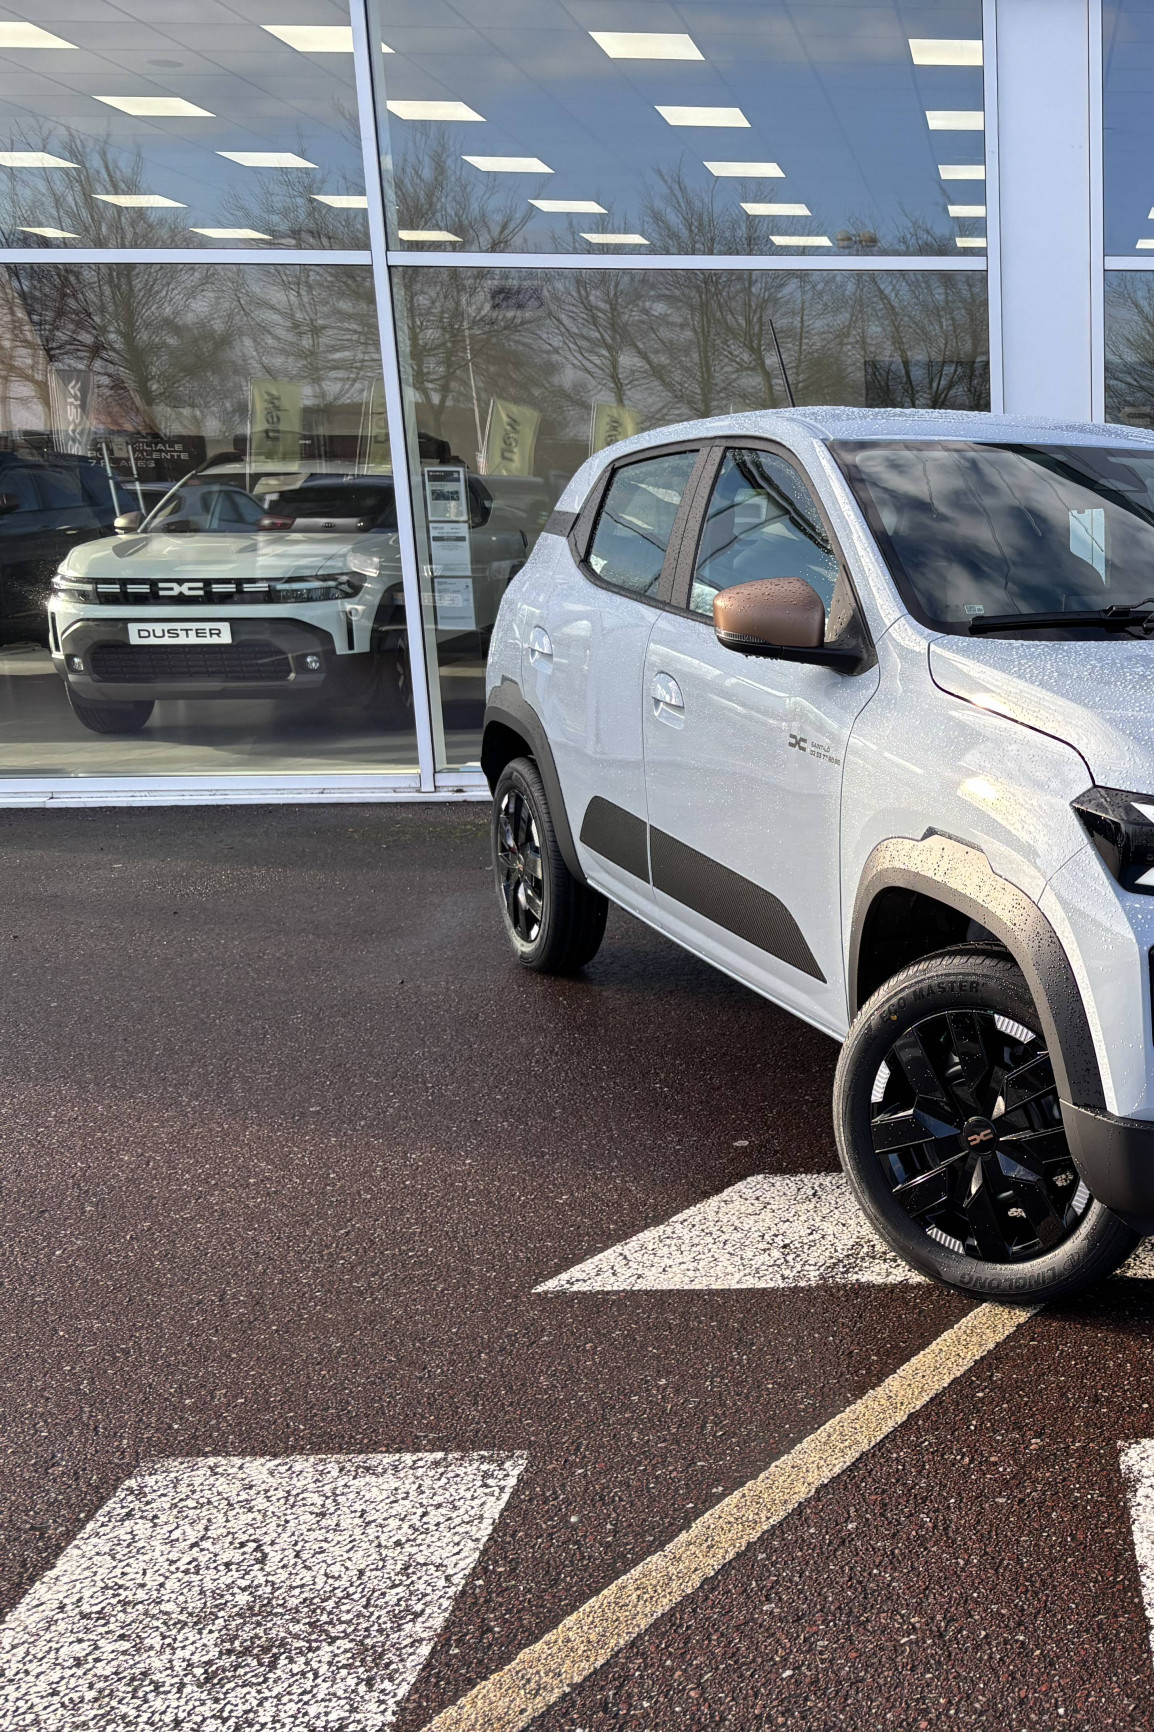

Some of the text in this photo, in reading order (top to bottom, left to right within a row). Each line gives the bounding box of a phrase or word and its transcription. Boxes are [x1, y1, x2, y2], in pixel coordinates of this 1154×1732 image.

[501, 413, 521, 463] new
[137, 628, 222, 639] DUSTER
[912, 980, 980, 1002] MASTER
[959, 1265, 1058, 1291] LINGLONG
